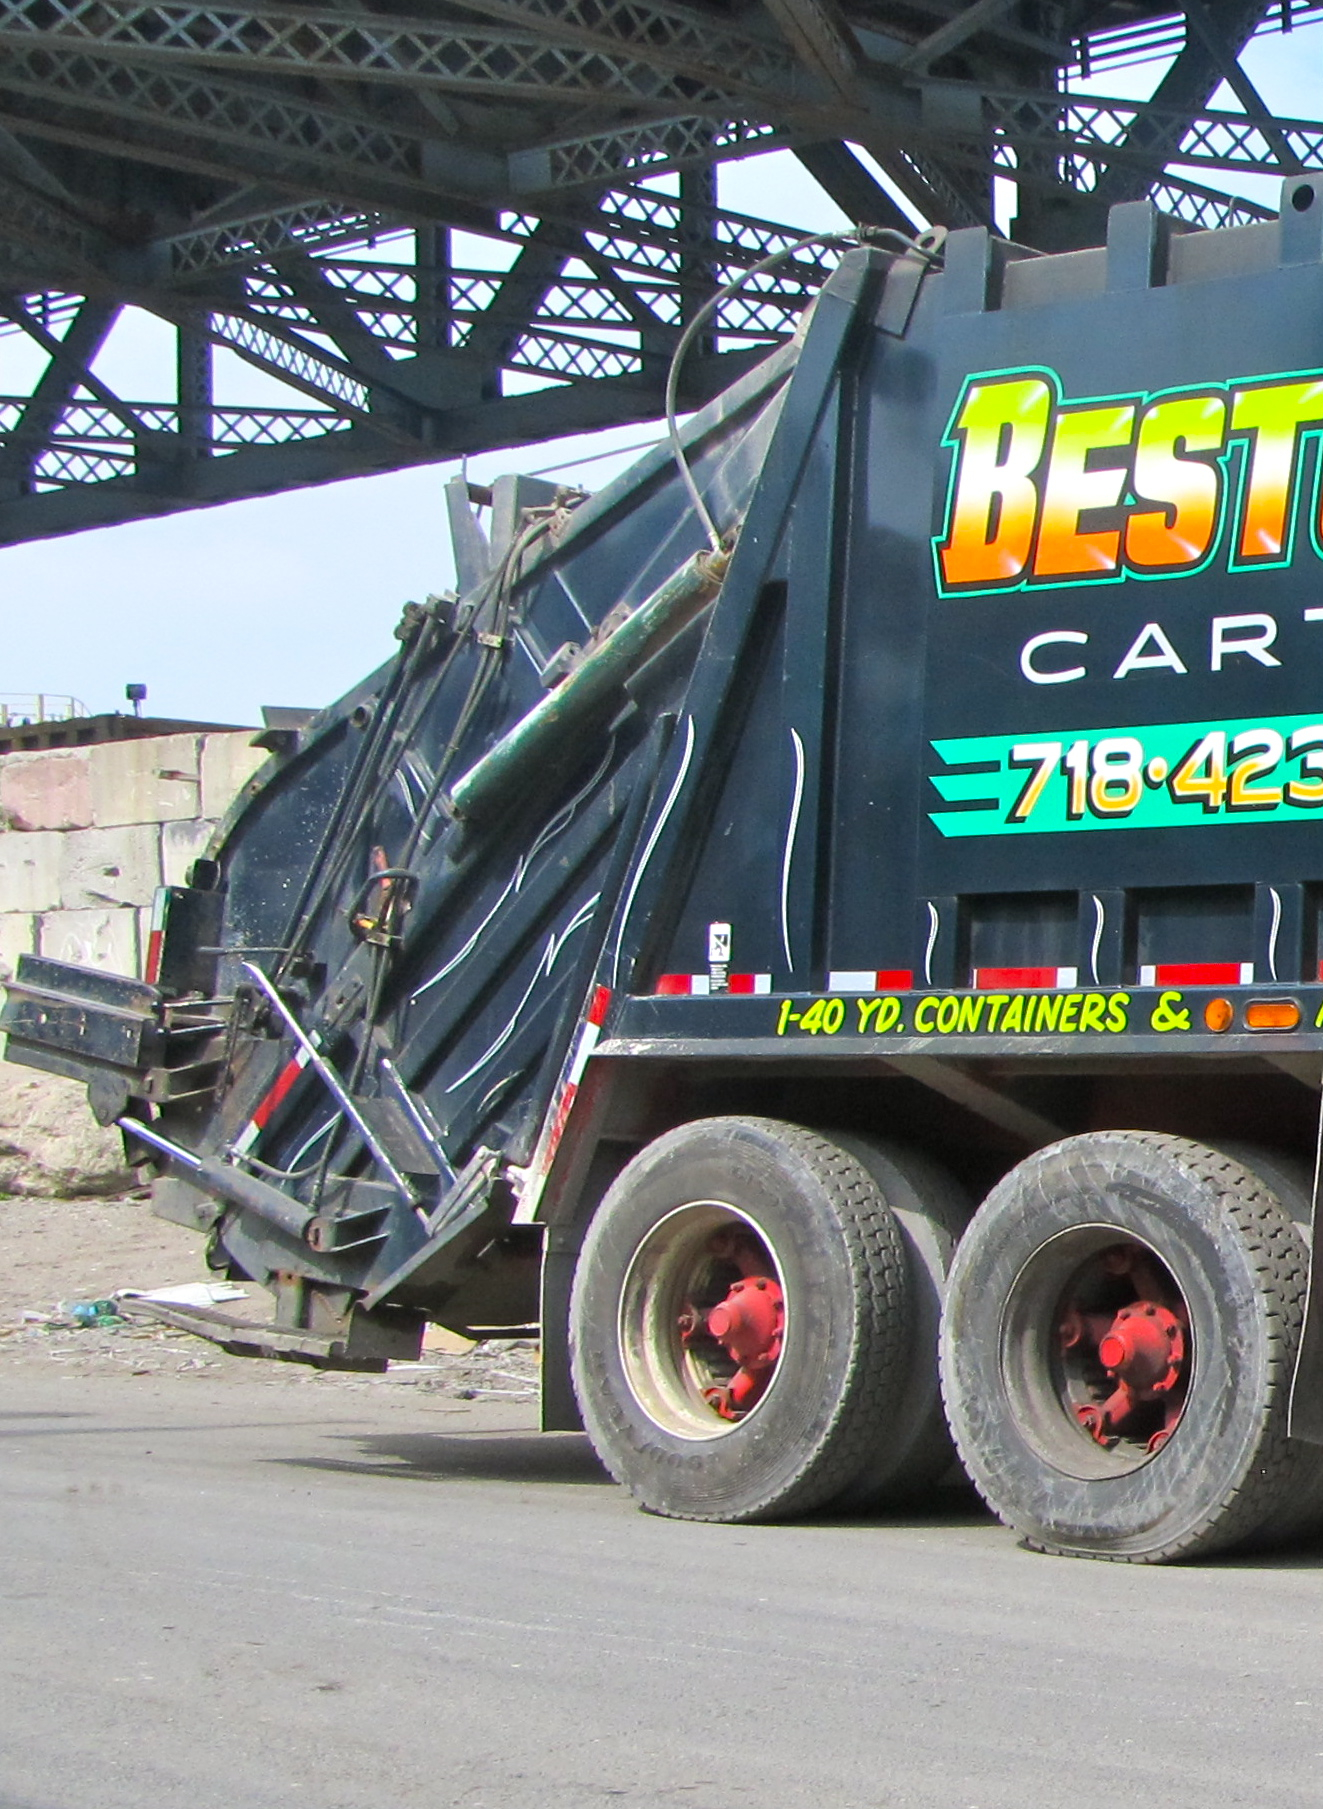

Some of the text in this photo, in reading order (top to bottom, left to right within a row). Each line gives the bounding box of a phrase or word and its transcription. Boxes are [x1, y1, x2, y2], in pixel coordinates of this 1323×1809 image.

[777, 997, 846, 1036] 1-40
[855, 996, 905, 1034] YD.
[914, 991, 1131, 1034] CONTAINERS
[1151, 990, 1192, 1032] &
